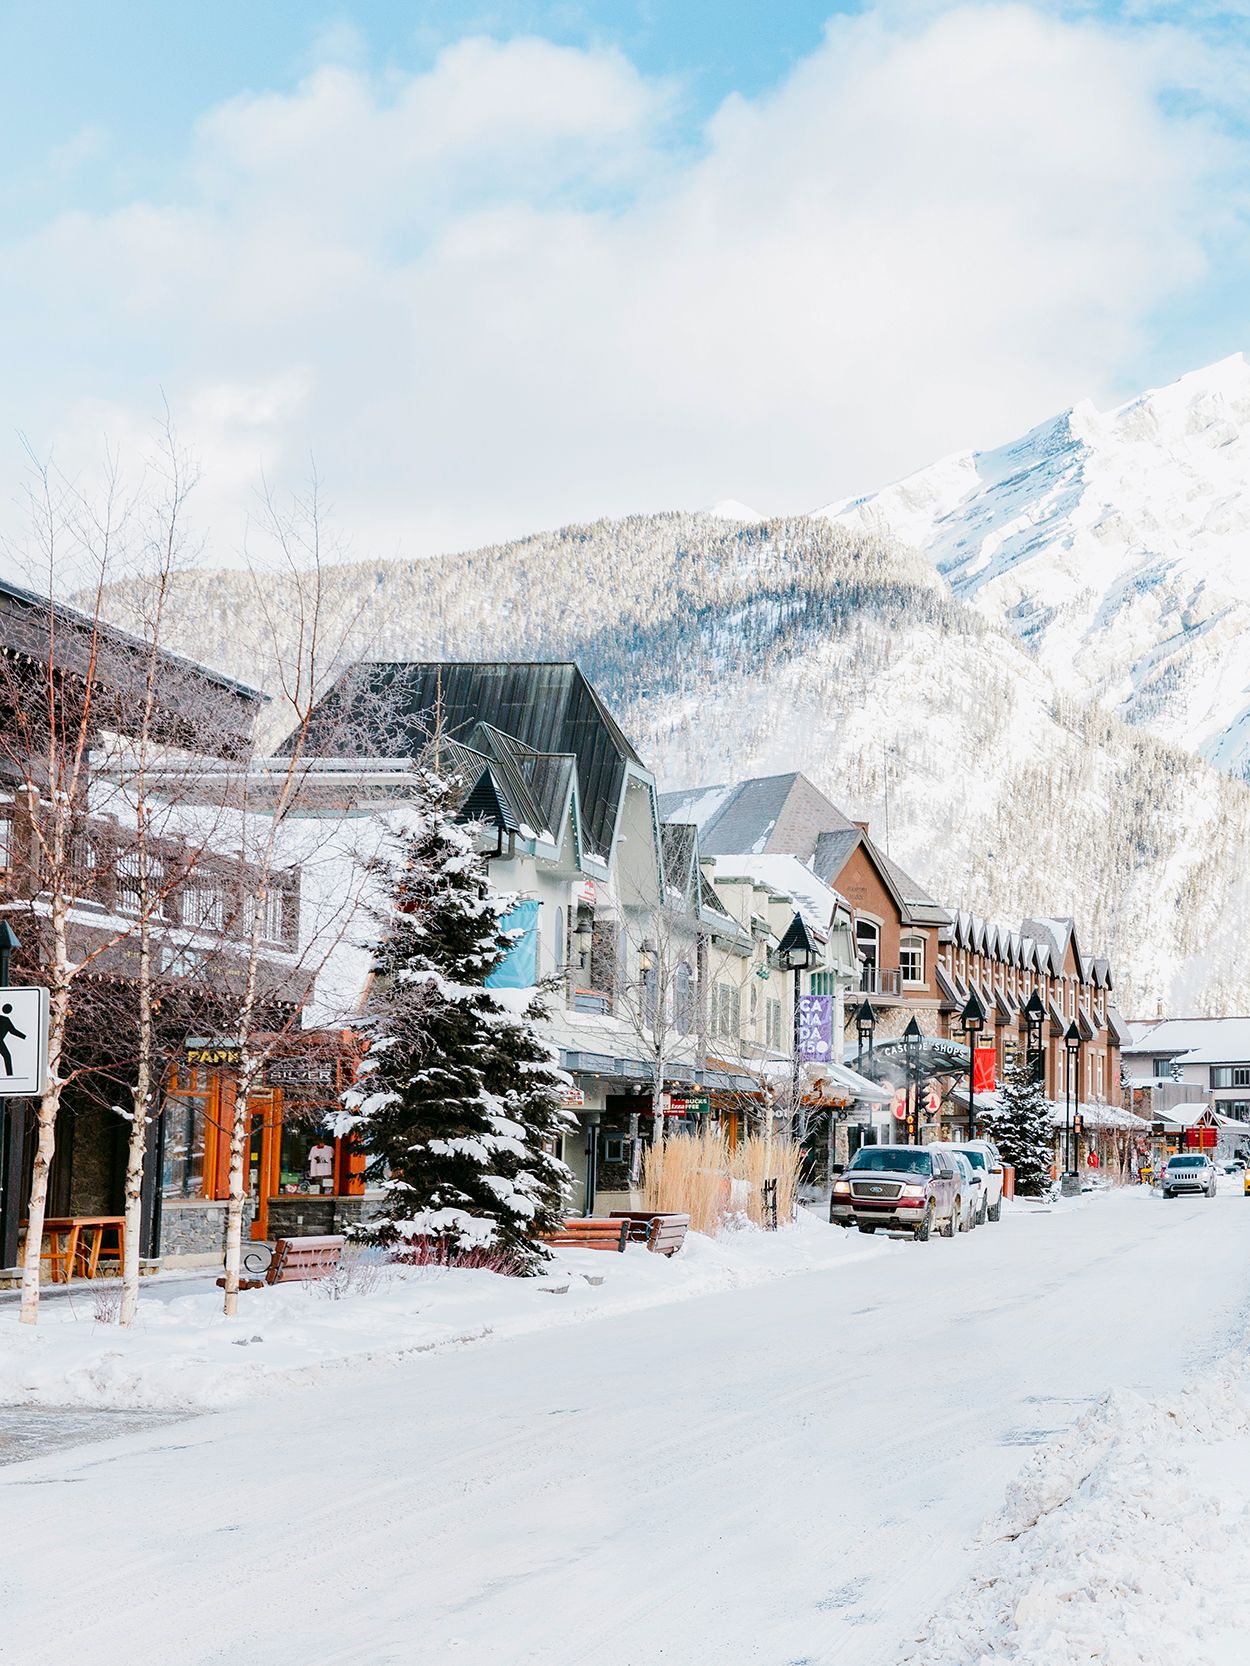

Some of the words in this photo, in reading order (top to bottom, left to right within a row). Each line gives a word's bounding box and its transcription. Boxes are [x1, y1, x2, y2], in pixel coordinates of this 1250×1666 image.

[798, 1040, 829, 1054] 150
[934, 1043, 965, 1058] SHOPS
[270, 1070, 331, 1080] SILVER
